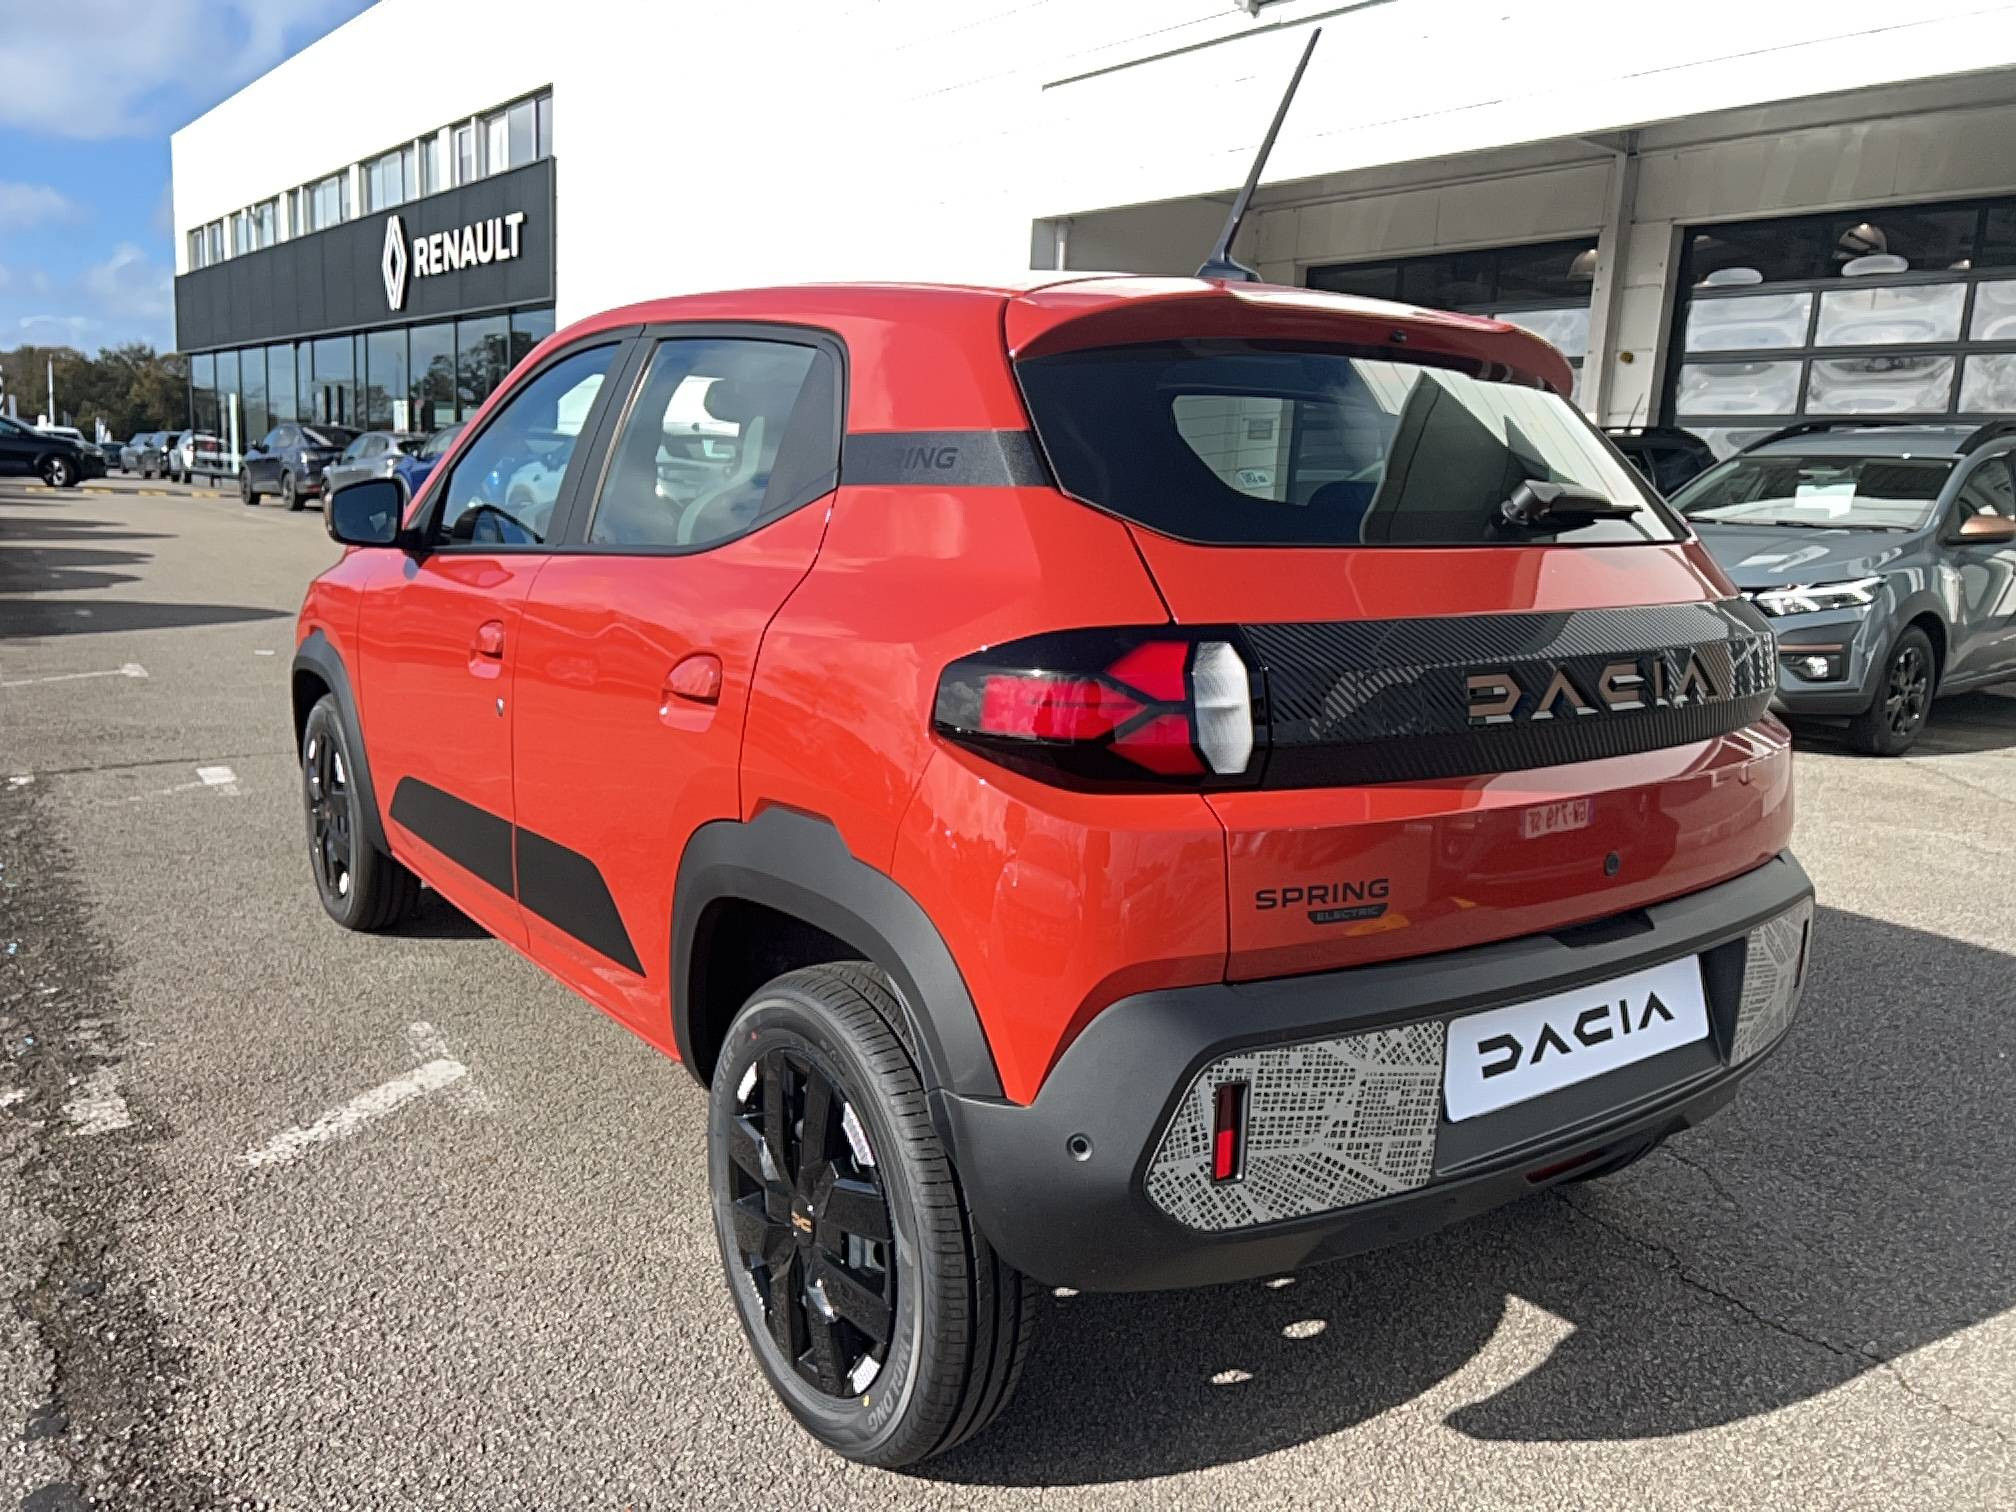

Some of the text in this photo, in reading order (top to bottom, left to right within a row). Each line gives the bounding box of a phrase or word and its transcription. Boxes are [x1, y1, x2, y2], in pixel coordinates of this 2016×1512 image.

[413, 211, 524, 278] RENAULT
[1466, 650, 1720, 724] DACIA
[1255, 878, 1389, 910] SPRING
[1316, 906, 1379, 921] ELECTRIC
[1477, 990, 1675, 1080] DACIA
